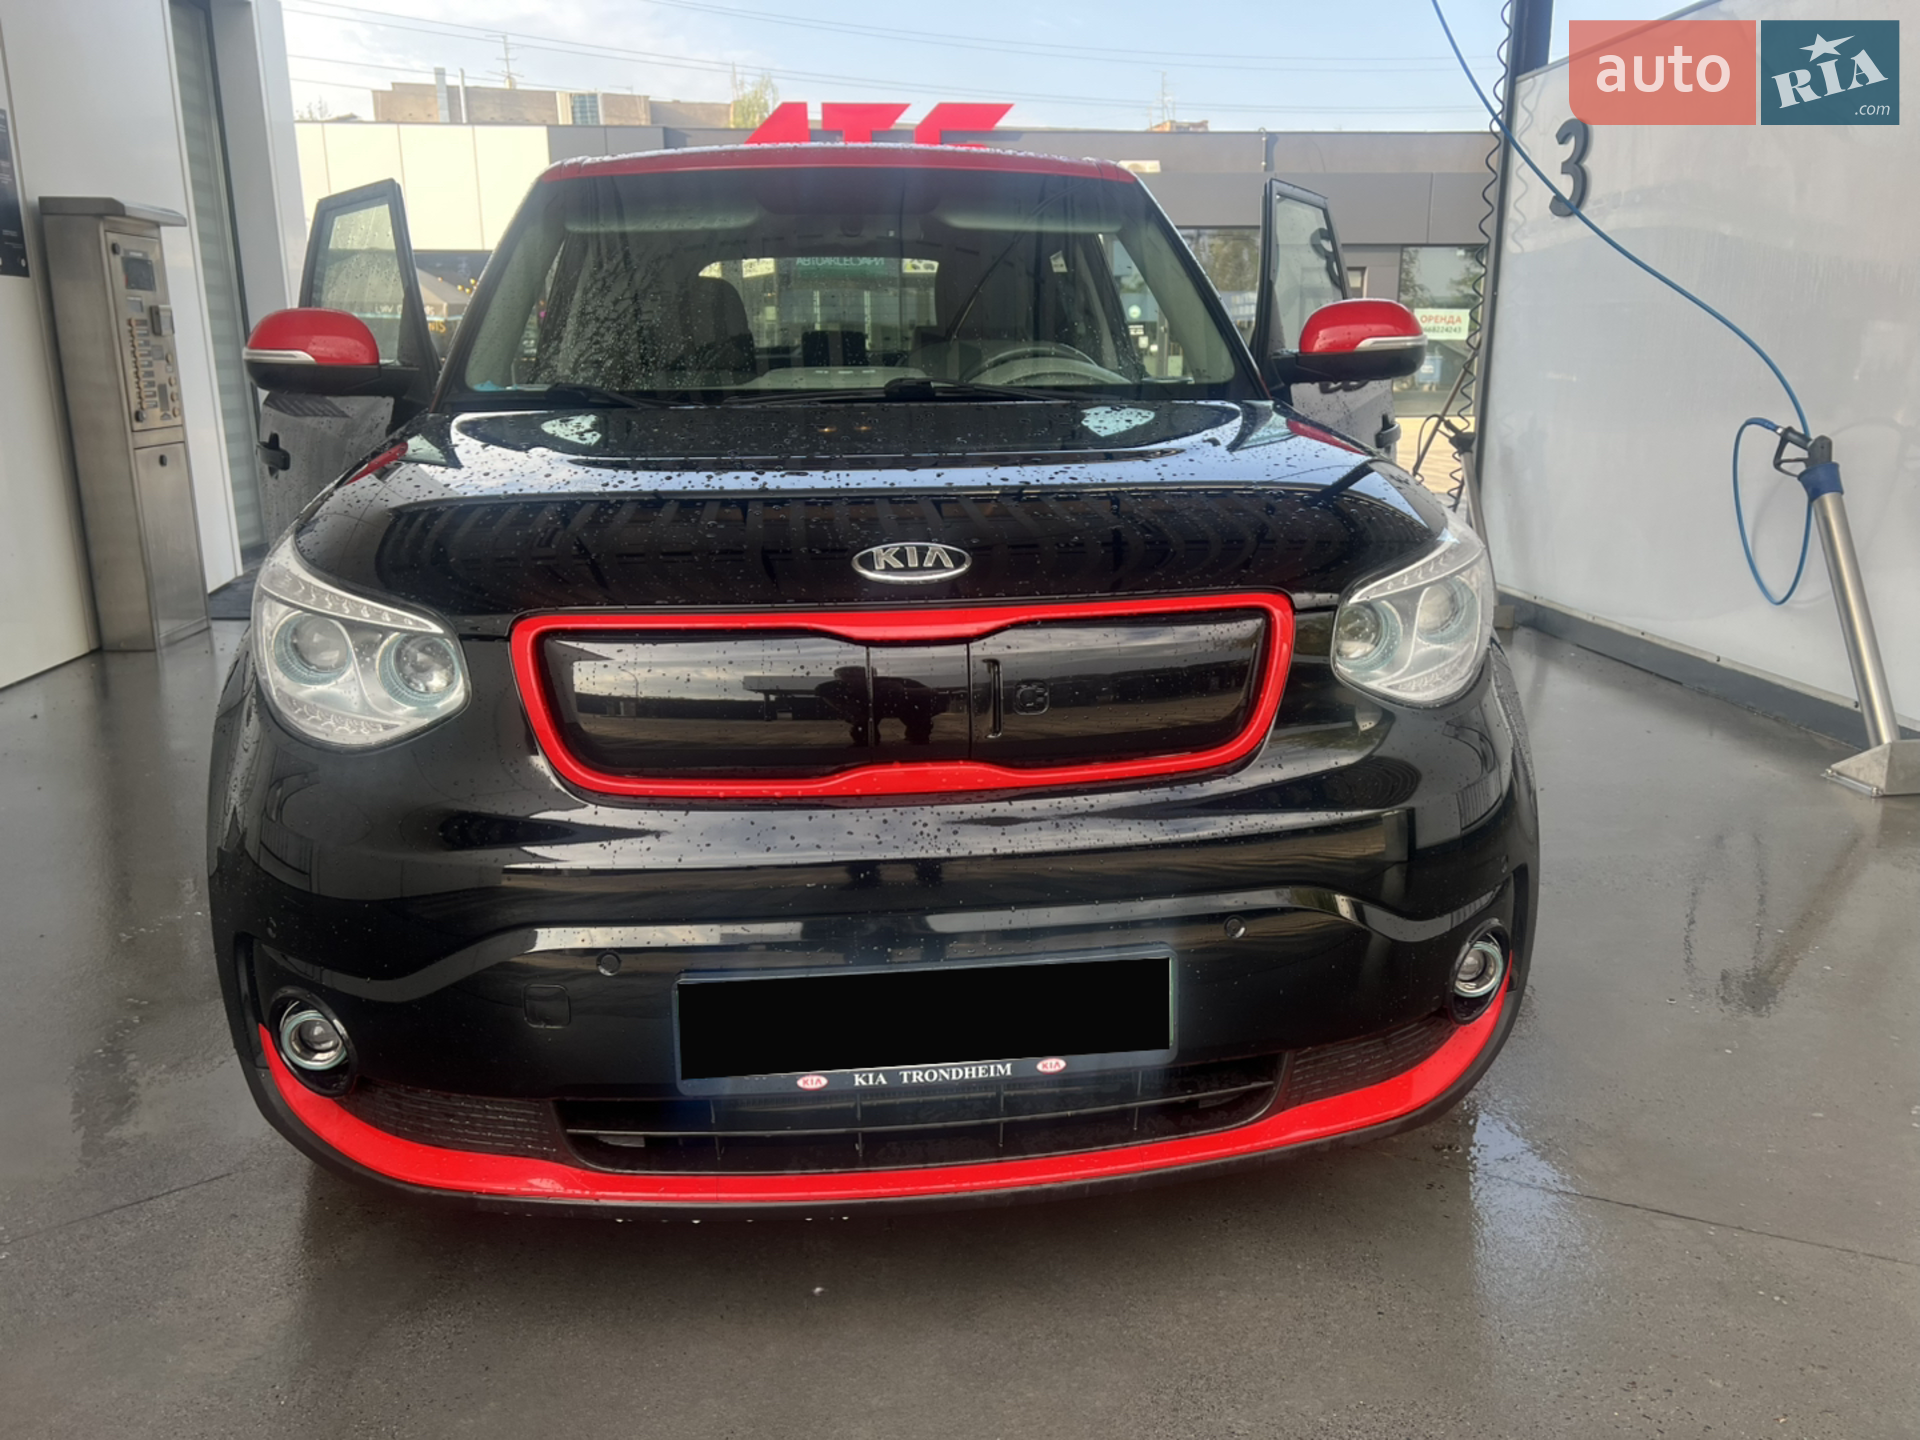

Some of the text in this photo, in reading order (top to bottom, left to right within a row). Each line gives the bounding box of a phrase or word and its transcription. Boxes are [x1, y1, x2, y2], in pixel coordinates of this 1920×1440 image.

[1549, 117, 1590, 218] 3
[1420, 314, 1462, 325] ОРЕНДА
[1422, 325, 1462, 333] 668224243
[871, 545, 955, 571] KIA
[1041, 1060, 1062, 1071] KIA
[853, 1062, 1013, 1087] KIA TRONDHEIM
[801, 1077, 823, 1087] KIA
